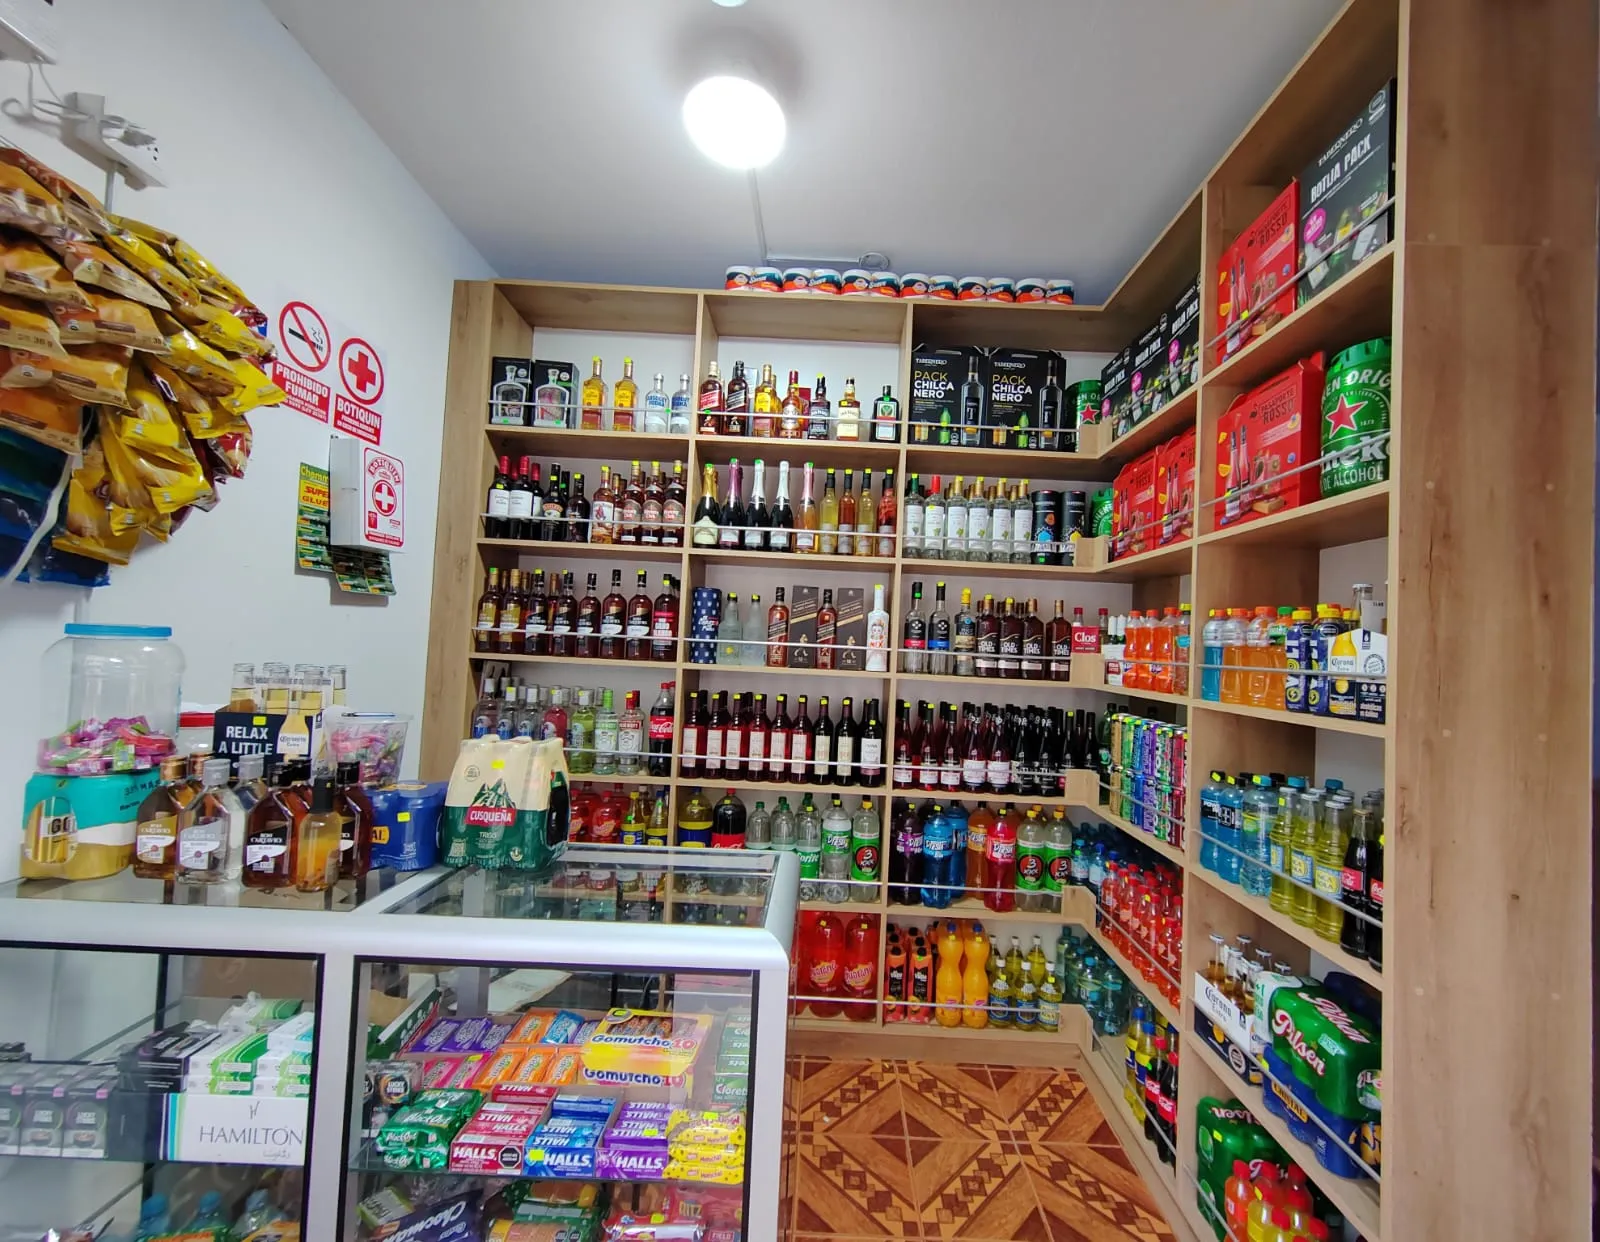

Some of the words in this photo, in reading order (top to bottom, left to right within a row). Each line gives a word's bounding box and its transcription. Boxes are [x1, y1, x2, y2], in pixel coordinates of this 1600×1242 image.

[1343, 134, 1373, 171] PACK
[275, 363, 328, 398] PROHIBIDO
[914, 371, 948, 381] PACK
[992, 374, 1026, 385] PACK
[1345, 369, 1391, 388] ORIG
[914, 380, 954, 391] CHILCA
[992, 384, 1032, 395] CHILCA
[285, 381, 319, 406] FUMAR
[913, 389, 945, 398] NERO
[992, 393, 1023, 402] NERO
[337, 397, 380, 429] BOTIQUIN
[1263, 401, 1295, 425] ROSSO
[1333, 462, 1384, 488] ALCOHOL
[304, 486, 329, 498] SUPE
[1074, 631, 1097, 643] Clos
[226, 725, 268, 740] RELAX
[218, 743, 228, 753] A
[232, 742, 273, 755] LITTLE
[470, 809, 512, 823] CUSQUEÑA
[1205, 986, 1232, 1017] Corona
[591, 1034, 672, 1048] Gomutcho
[673, 1038, 696, 1050] 10
[1271, 1008, 1326, 1076] Pilsen
[584, 1067, 661, 1085] Gomutcho
[478, 1113, 513, 1122] HALLS
[492, 1123, 527, 1132] HALLS
[200, 1126, 304, 1146] HAMILTON
[533, 1137, 570, 1146] HALLS
[453, 1147, 497, 1160] HALLS
[543, 1153, 591, 1167] HALLS
[616, 1157, 664, 1169] HALLS
[680, 1200, 703, 1219] RITZ
